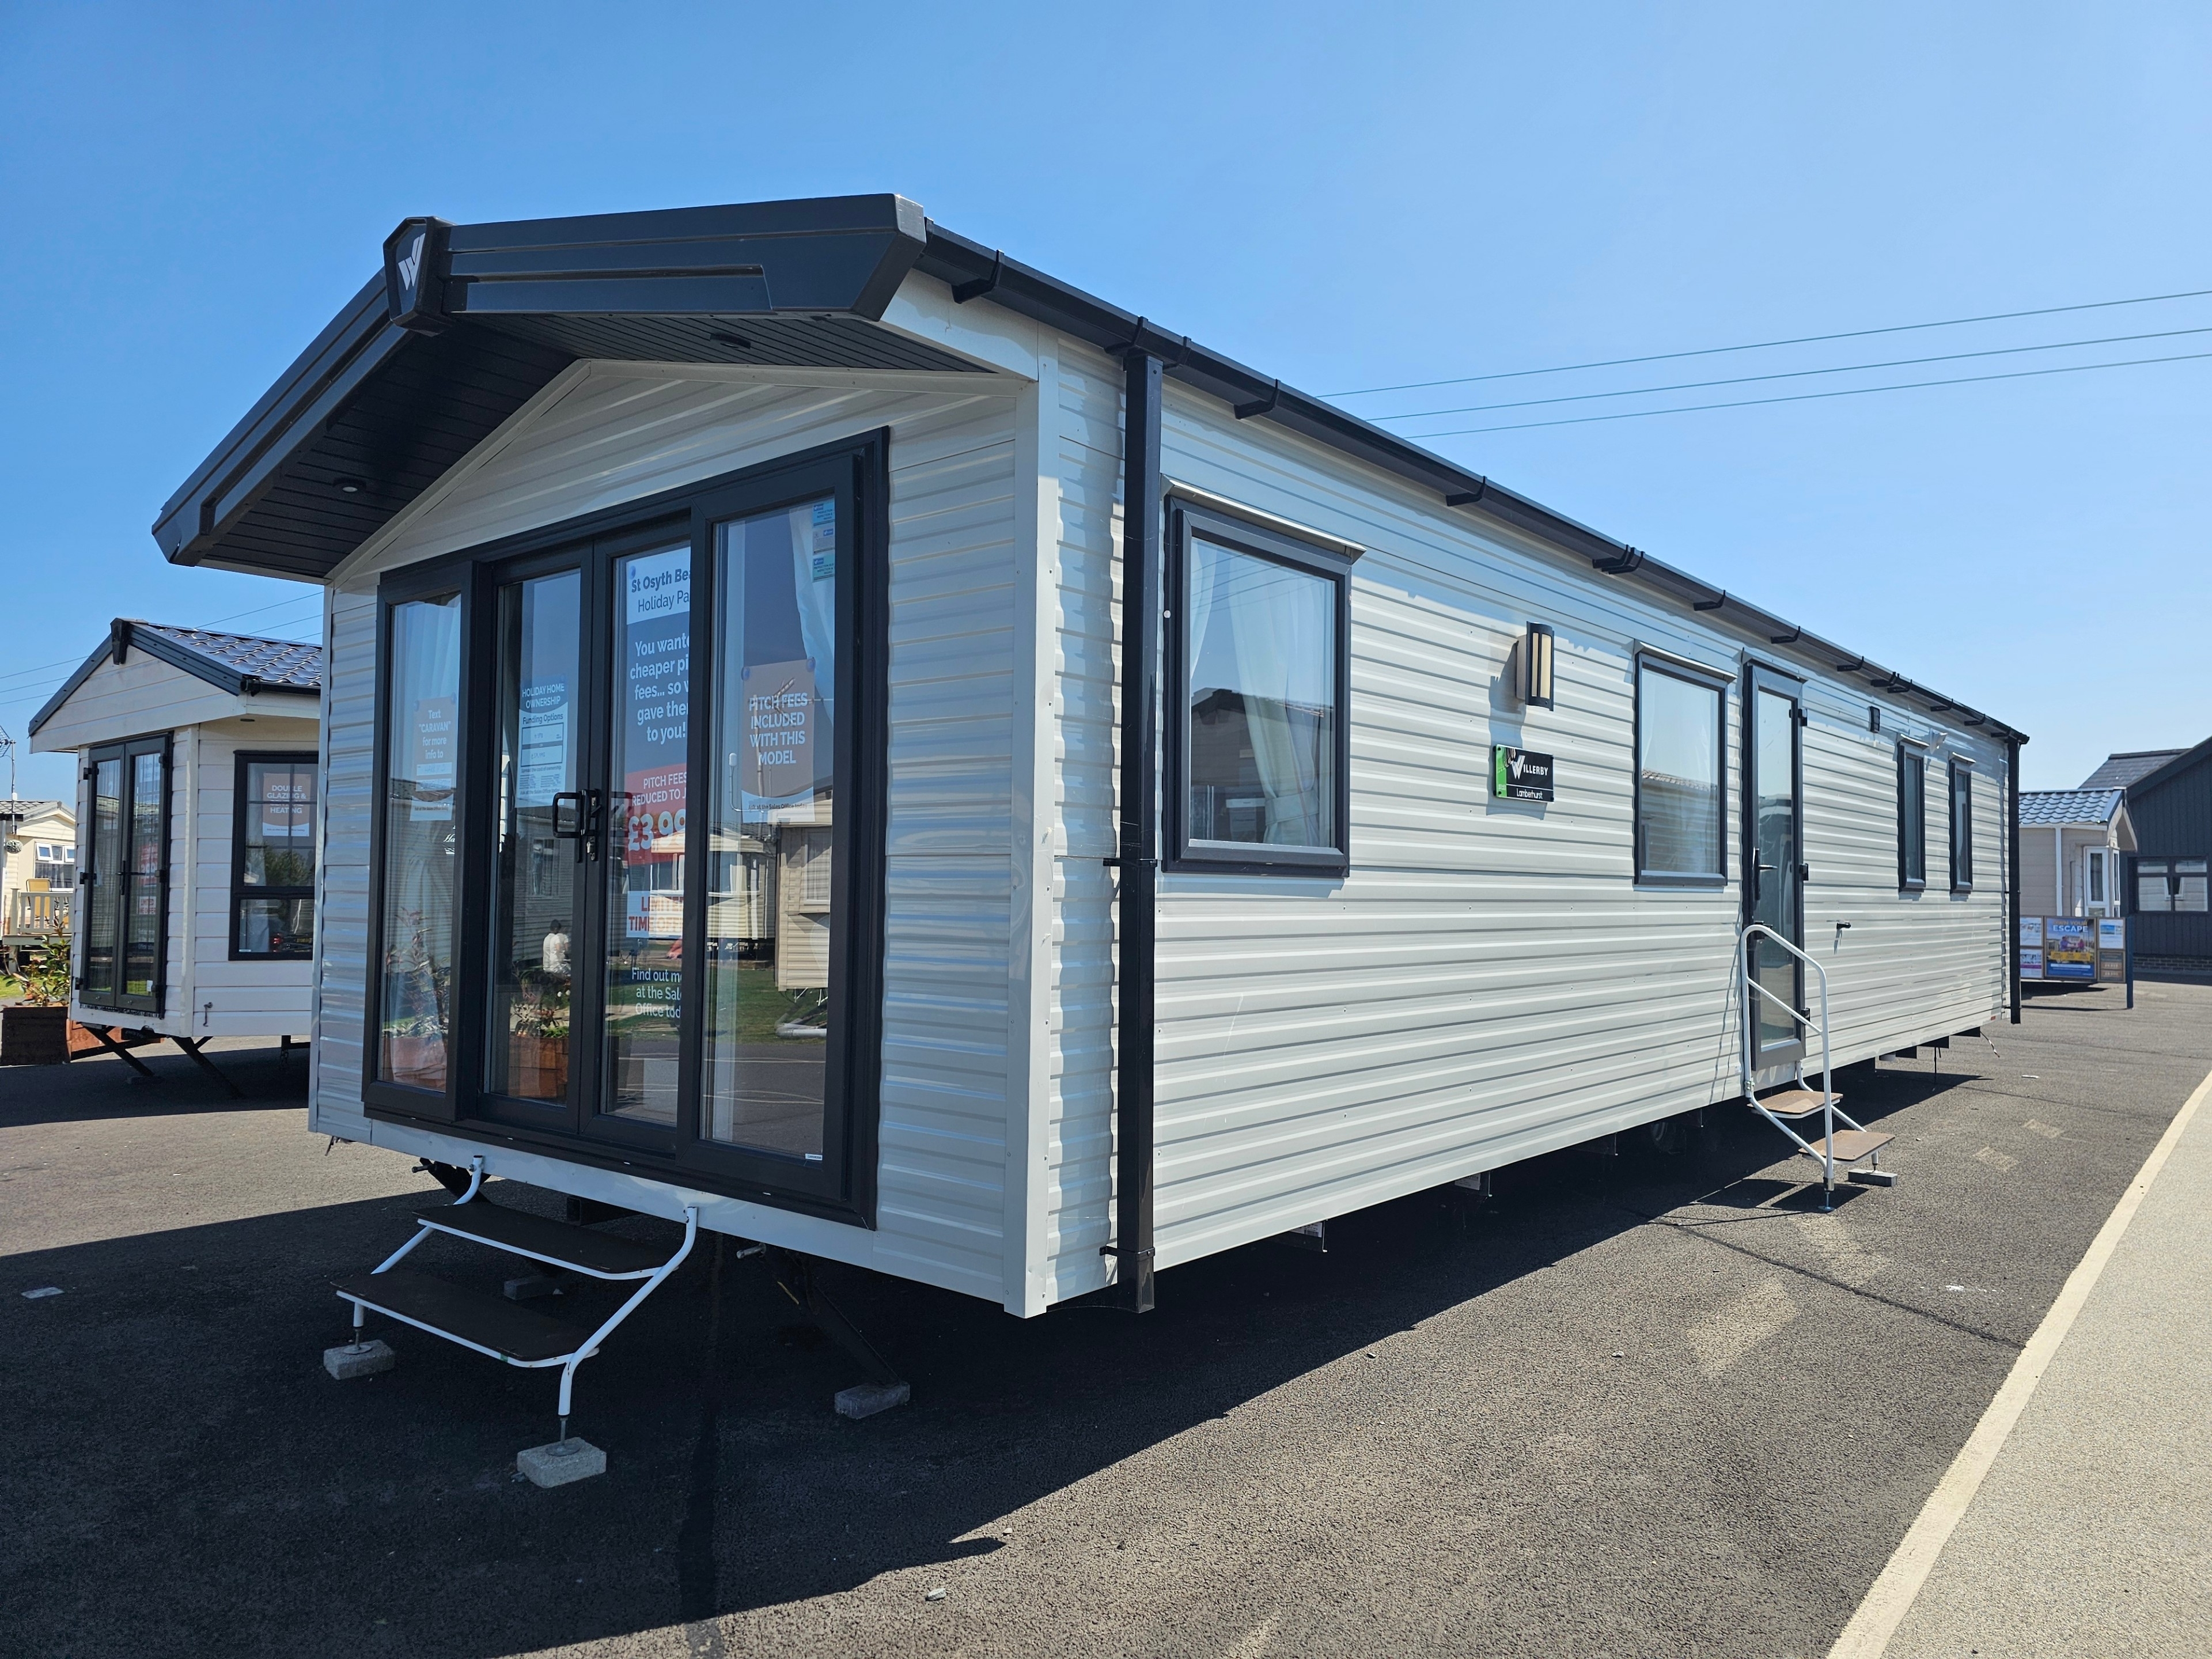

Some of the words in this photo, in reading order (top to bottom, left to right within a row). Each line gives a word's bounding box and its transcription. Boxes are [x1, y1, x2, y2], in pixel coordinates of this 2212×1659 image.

[631, 578, 641, 593] St
[643, 571, 672, 591] Osyth
[675, 568, 691, 583] Be
[638, 594, 675, 613] Holiday
[677, 590, 690, 604] Pa
[635, 641, 655, 657] You
[630, 660, 675, 680] cheaper
[677, 654, 688, 676] pi
[522, 685, 546, 698] HOLIDAY
[547, 683, 565, 694] HOME
[635, 684, 665, 700] fees...
[668, 681, 681, 695] so
[525, 695, 561, 709] OWNERSHIP
[749, 696, 778, 711] PITCH
[781, 692, 808, 708] FEES
[428, 709, 441, 719] Text
[522, 715, 543, 725] Funding
[543, 713, 563, 724] Options
[637, 706, 664, 726] gave
[666, 700, 688, 717] the
[751, 712, 805, 729] INCLUDED
[419, 721, 452, 733] "CARAVAN"
[647, 726, 658, 742] to
[660, 722, 685, 745] you!
[422, 737, 431, 747] for
[431, 737, 447, 745] more
[749, 732, 778, 748] WITH
[780, 730, 805, 745] THIS
[425, 749, 436, 759] info
[438, 749, 444, 758] to
[758, 750, 796, 766] MODEL
[1511, 755, 1548, 780] WILLERBY
[643, 774, 666, 789] PITCH
[632, 790, 668, 806] REDUCED
[669, 789, 681, 800] TO
[1516, 787, 1543, 800] Lamberhurst
[628, 916, 654, 931] TIME
[2053, 925, 2089, 933] ESCAPE
[631, 967, 651, 981] Find
[653, 969, 669, 982] out
[636, 987, 645, 998] at
[647, 986, 663, 999] the
[635, 1002, 664, 1017] Office
[666, 1004, 680, 1018] tod
